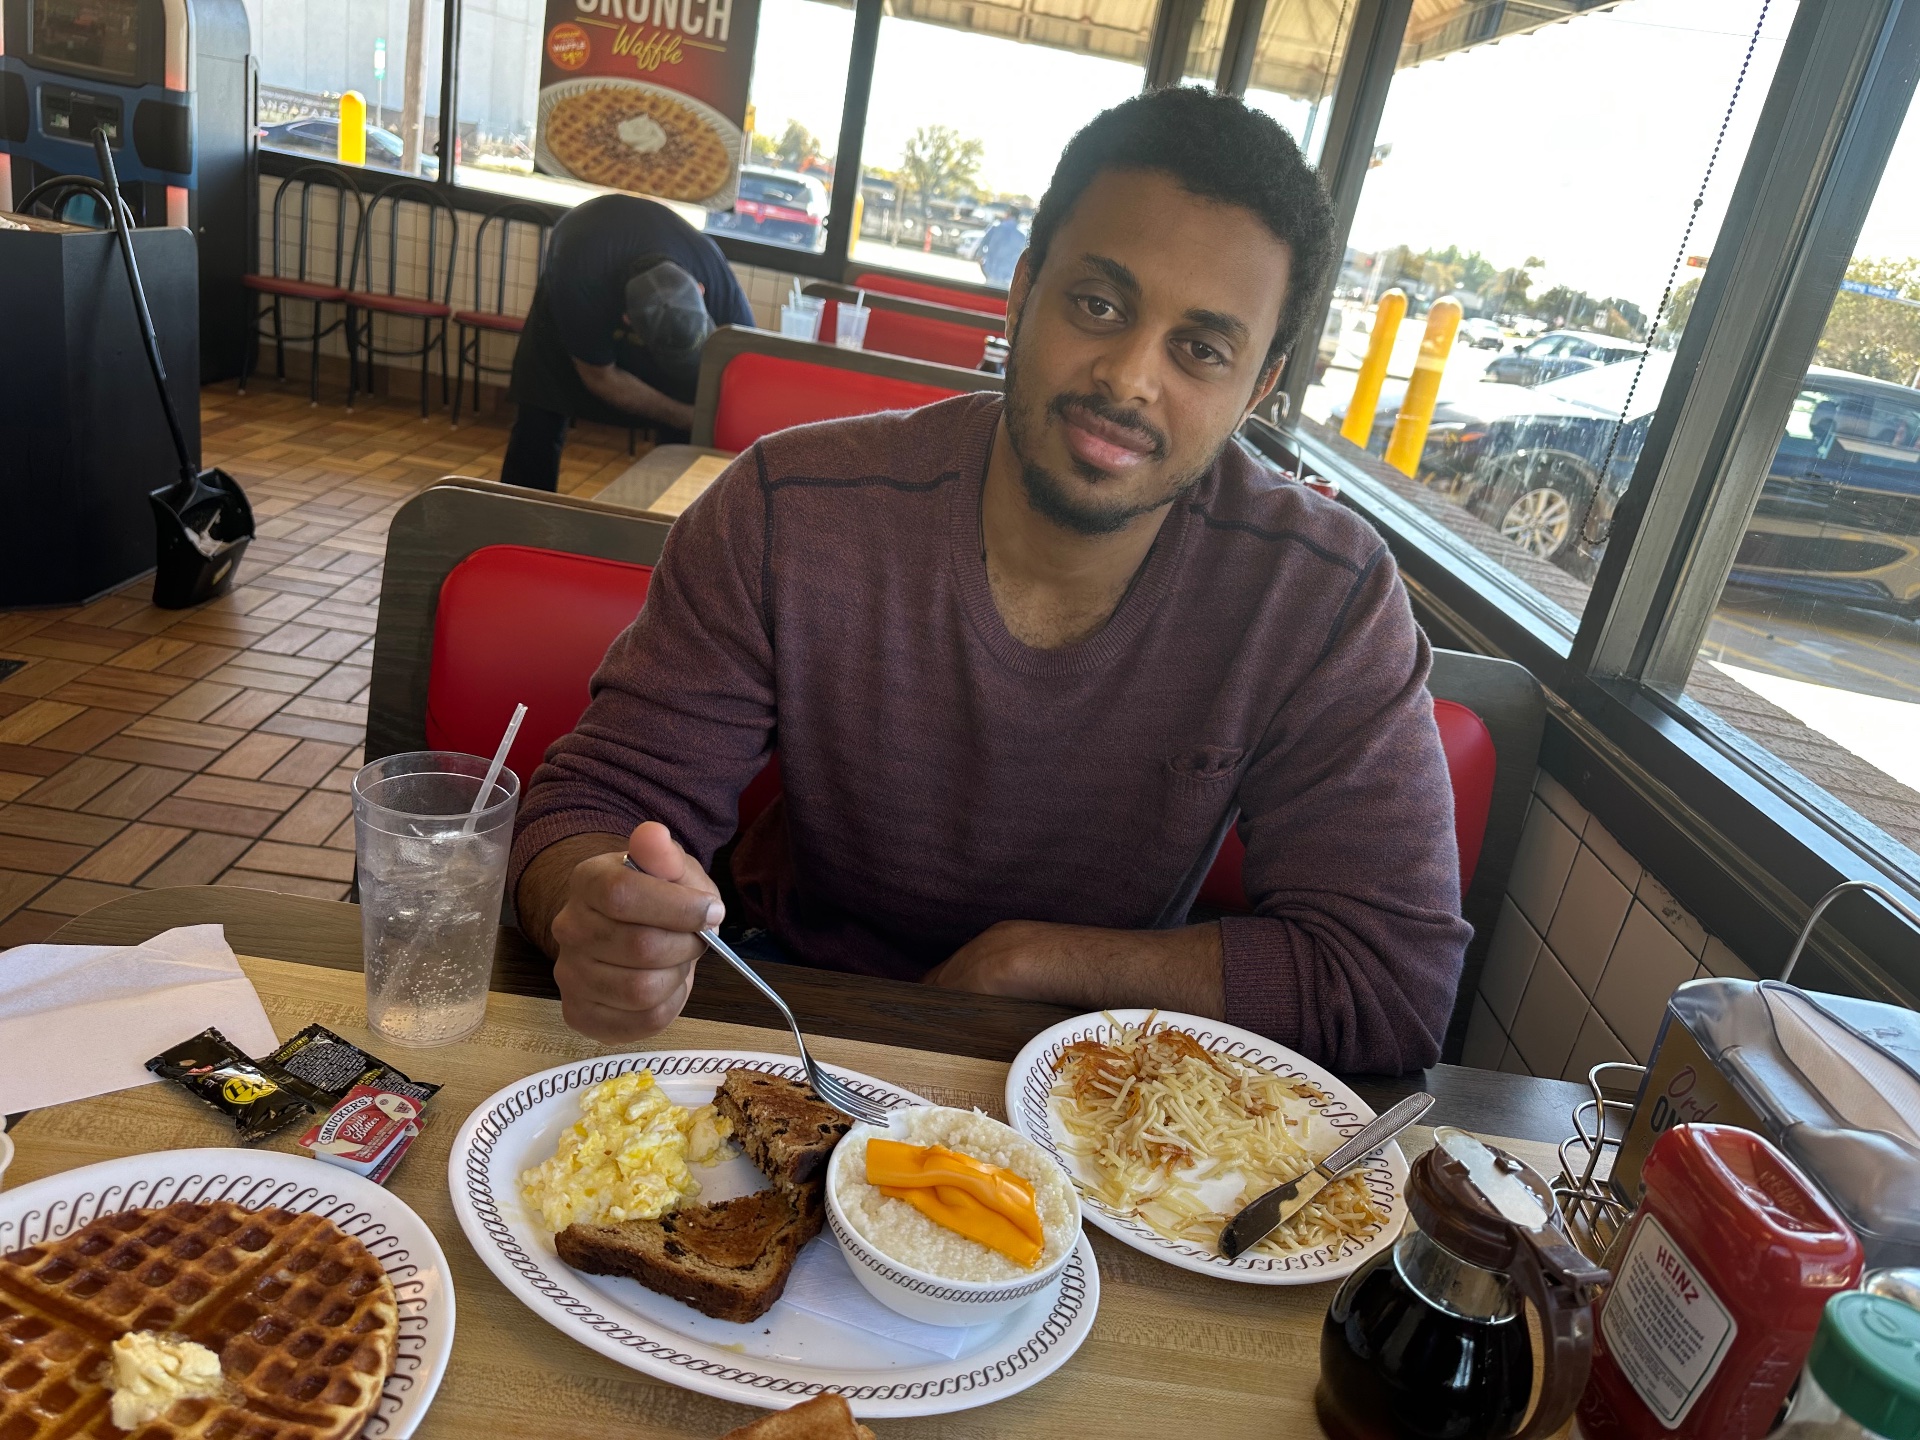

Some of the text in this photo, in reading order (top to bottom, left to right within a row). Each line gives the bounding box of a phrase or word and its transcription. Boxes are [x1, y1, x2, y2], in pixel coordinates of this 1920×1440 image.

[575, 0, 733, 41] UNCH
[611, 23, 684, 71] Waffle
[1668, 1066, 1718, 1123] Ord
[321, 1098, 369, 1141] SMUCKER'S
[343, 1114, 369, 1136] Apple
[352, 1117, 380, 1141] Butter
[1656, 1245, 1699, 1305] HEINZ
